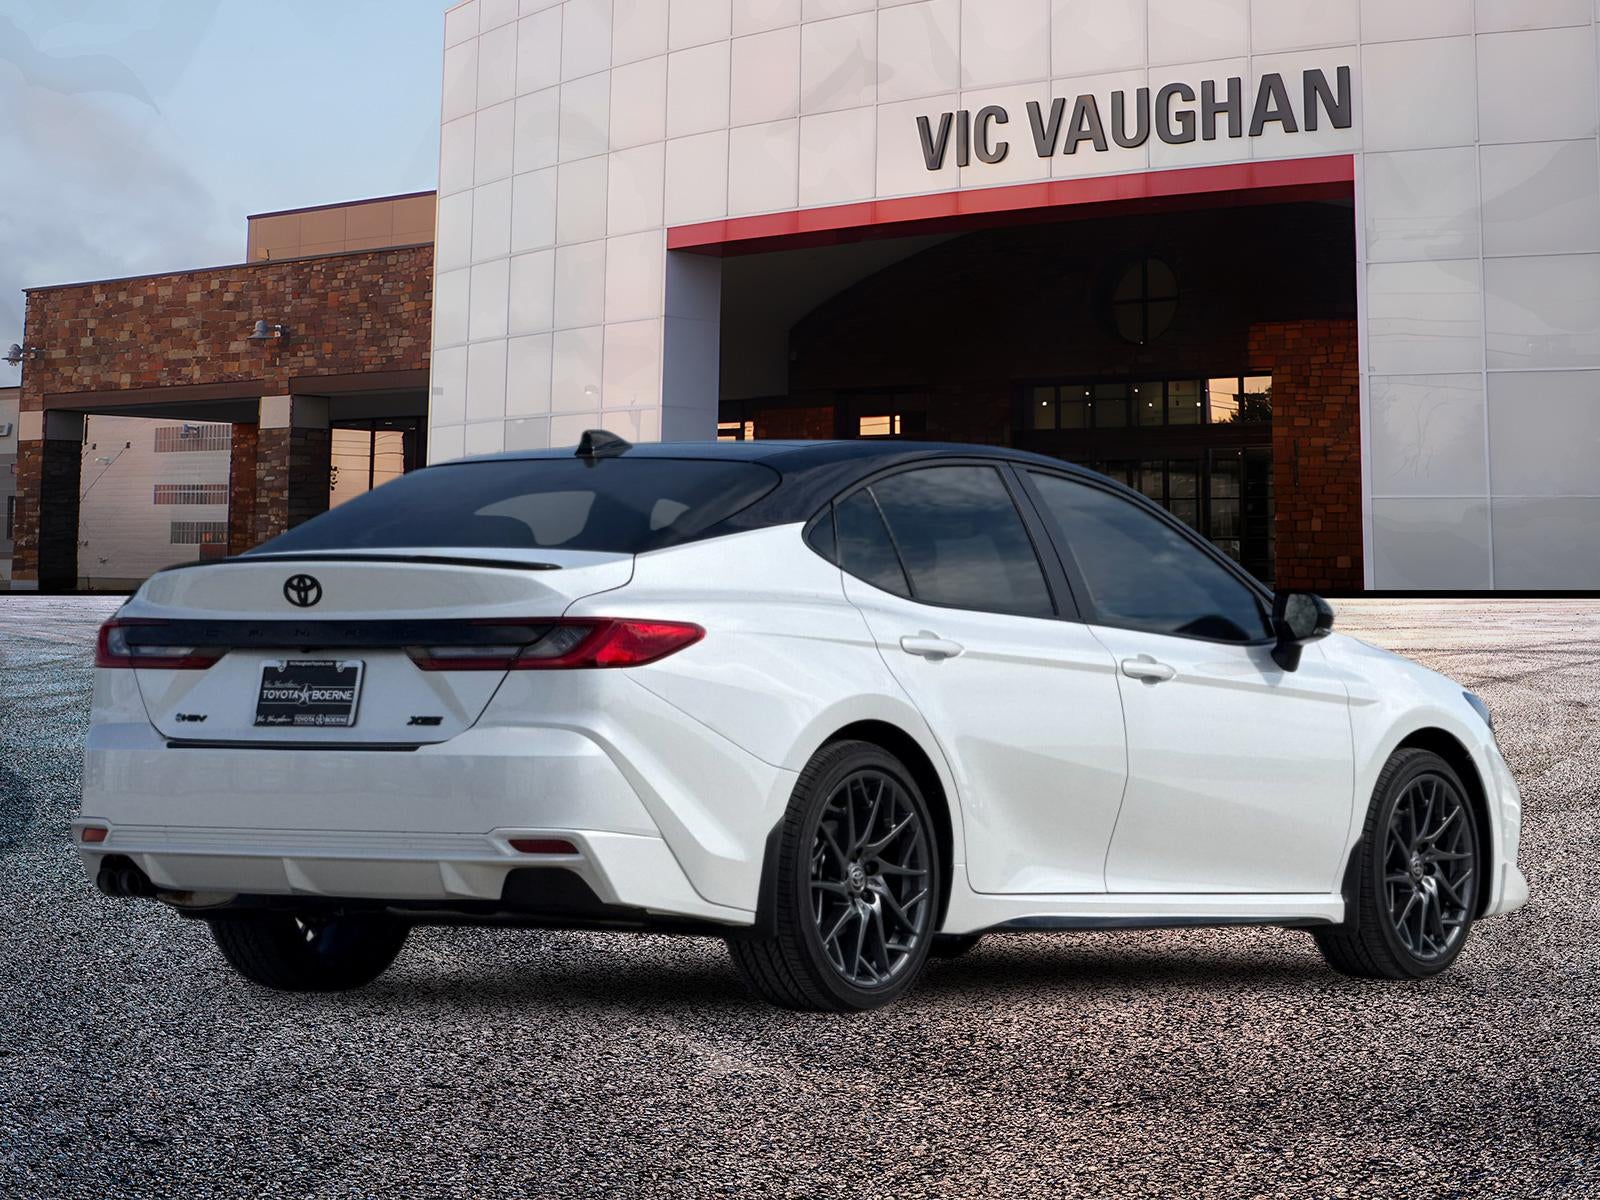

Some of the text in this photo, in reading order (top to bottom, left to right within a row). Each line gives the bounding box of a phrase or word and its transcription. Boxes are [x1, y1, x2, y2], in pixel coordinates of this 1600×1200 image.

[916, 66, 1352, 171] VIC VAUGHAN
[263, 690, 353, 701] TOYOTA BOERNE
